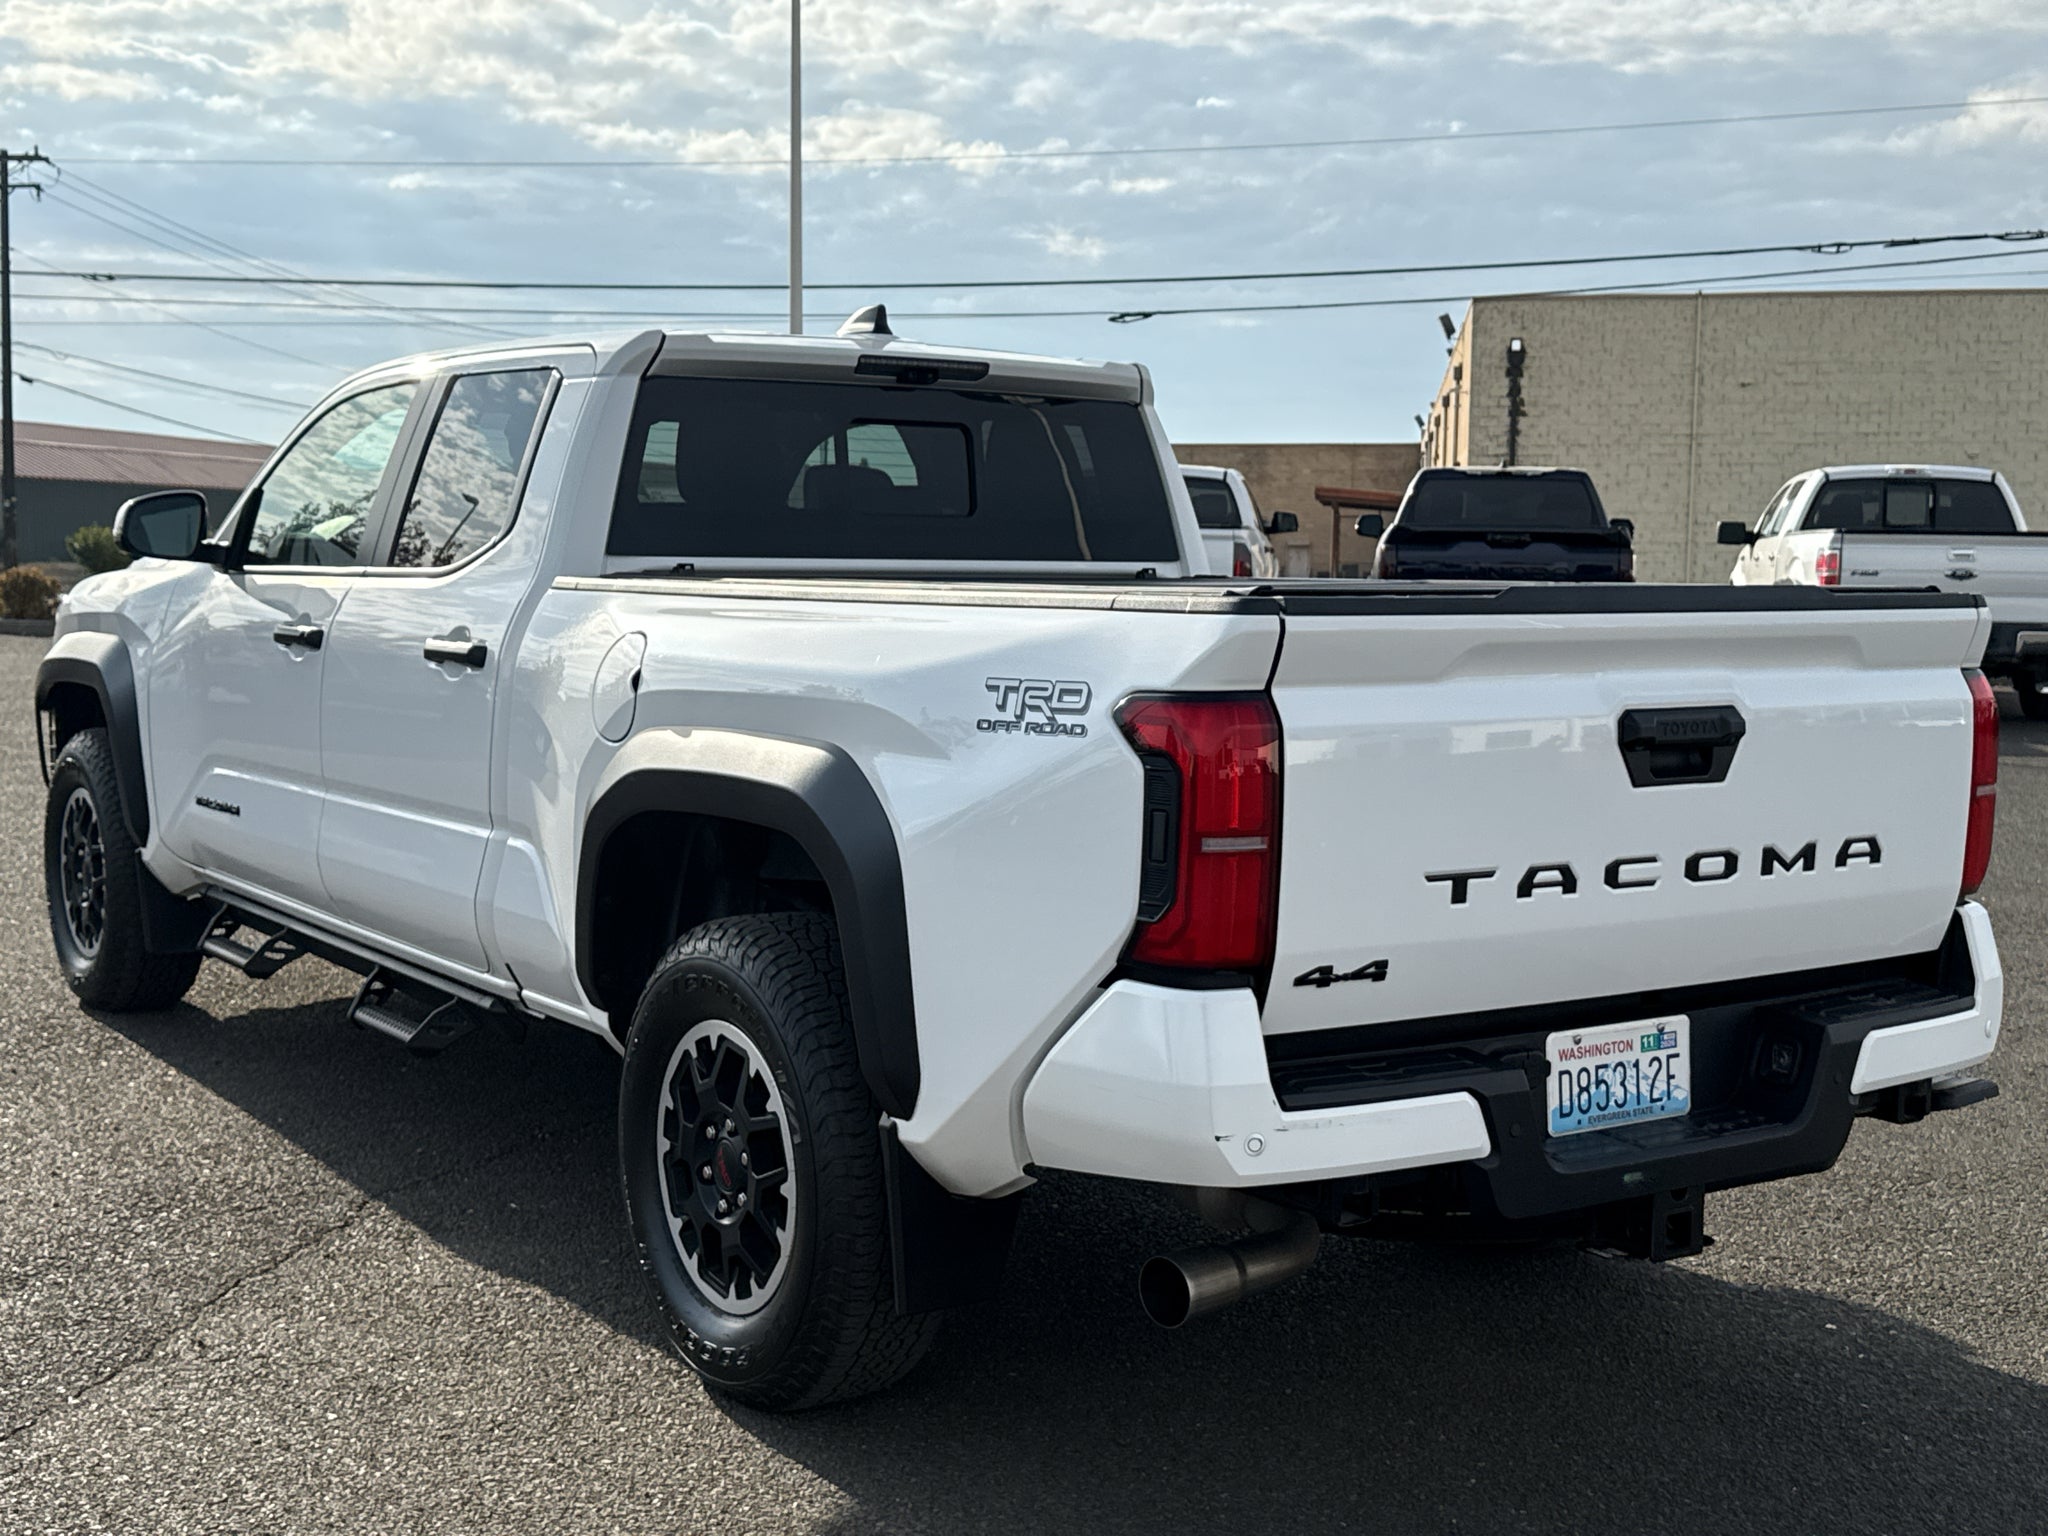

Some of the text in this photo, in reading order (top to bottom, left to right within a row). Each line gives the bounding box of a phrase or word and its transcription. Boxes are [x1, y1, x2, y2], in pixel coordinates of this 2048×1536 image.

[985, 677, 1093, 724] TRD
[976, 719, 1088, 738] OFF ROAD
[1661, 720, 1720, 737] TOYOTA
[1424, 835, 1883, 905] TACOMA
[1558, 1039, 1634, 1062] WASHINGTON
[1642, 1035, 1655, 1048] 11
[1558, 1053, 1680, 1119] D85312F
[1588, 1106, 1654, 1125] EVERGREEN STATE
